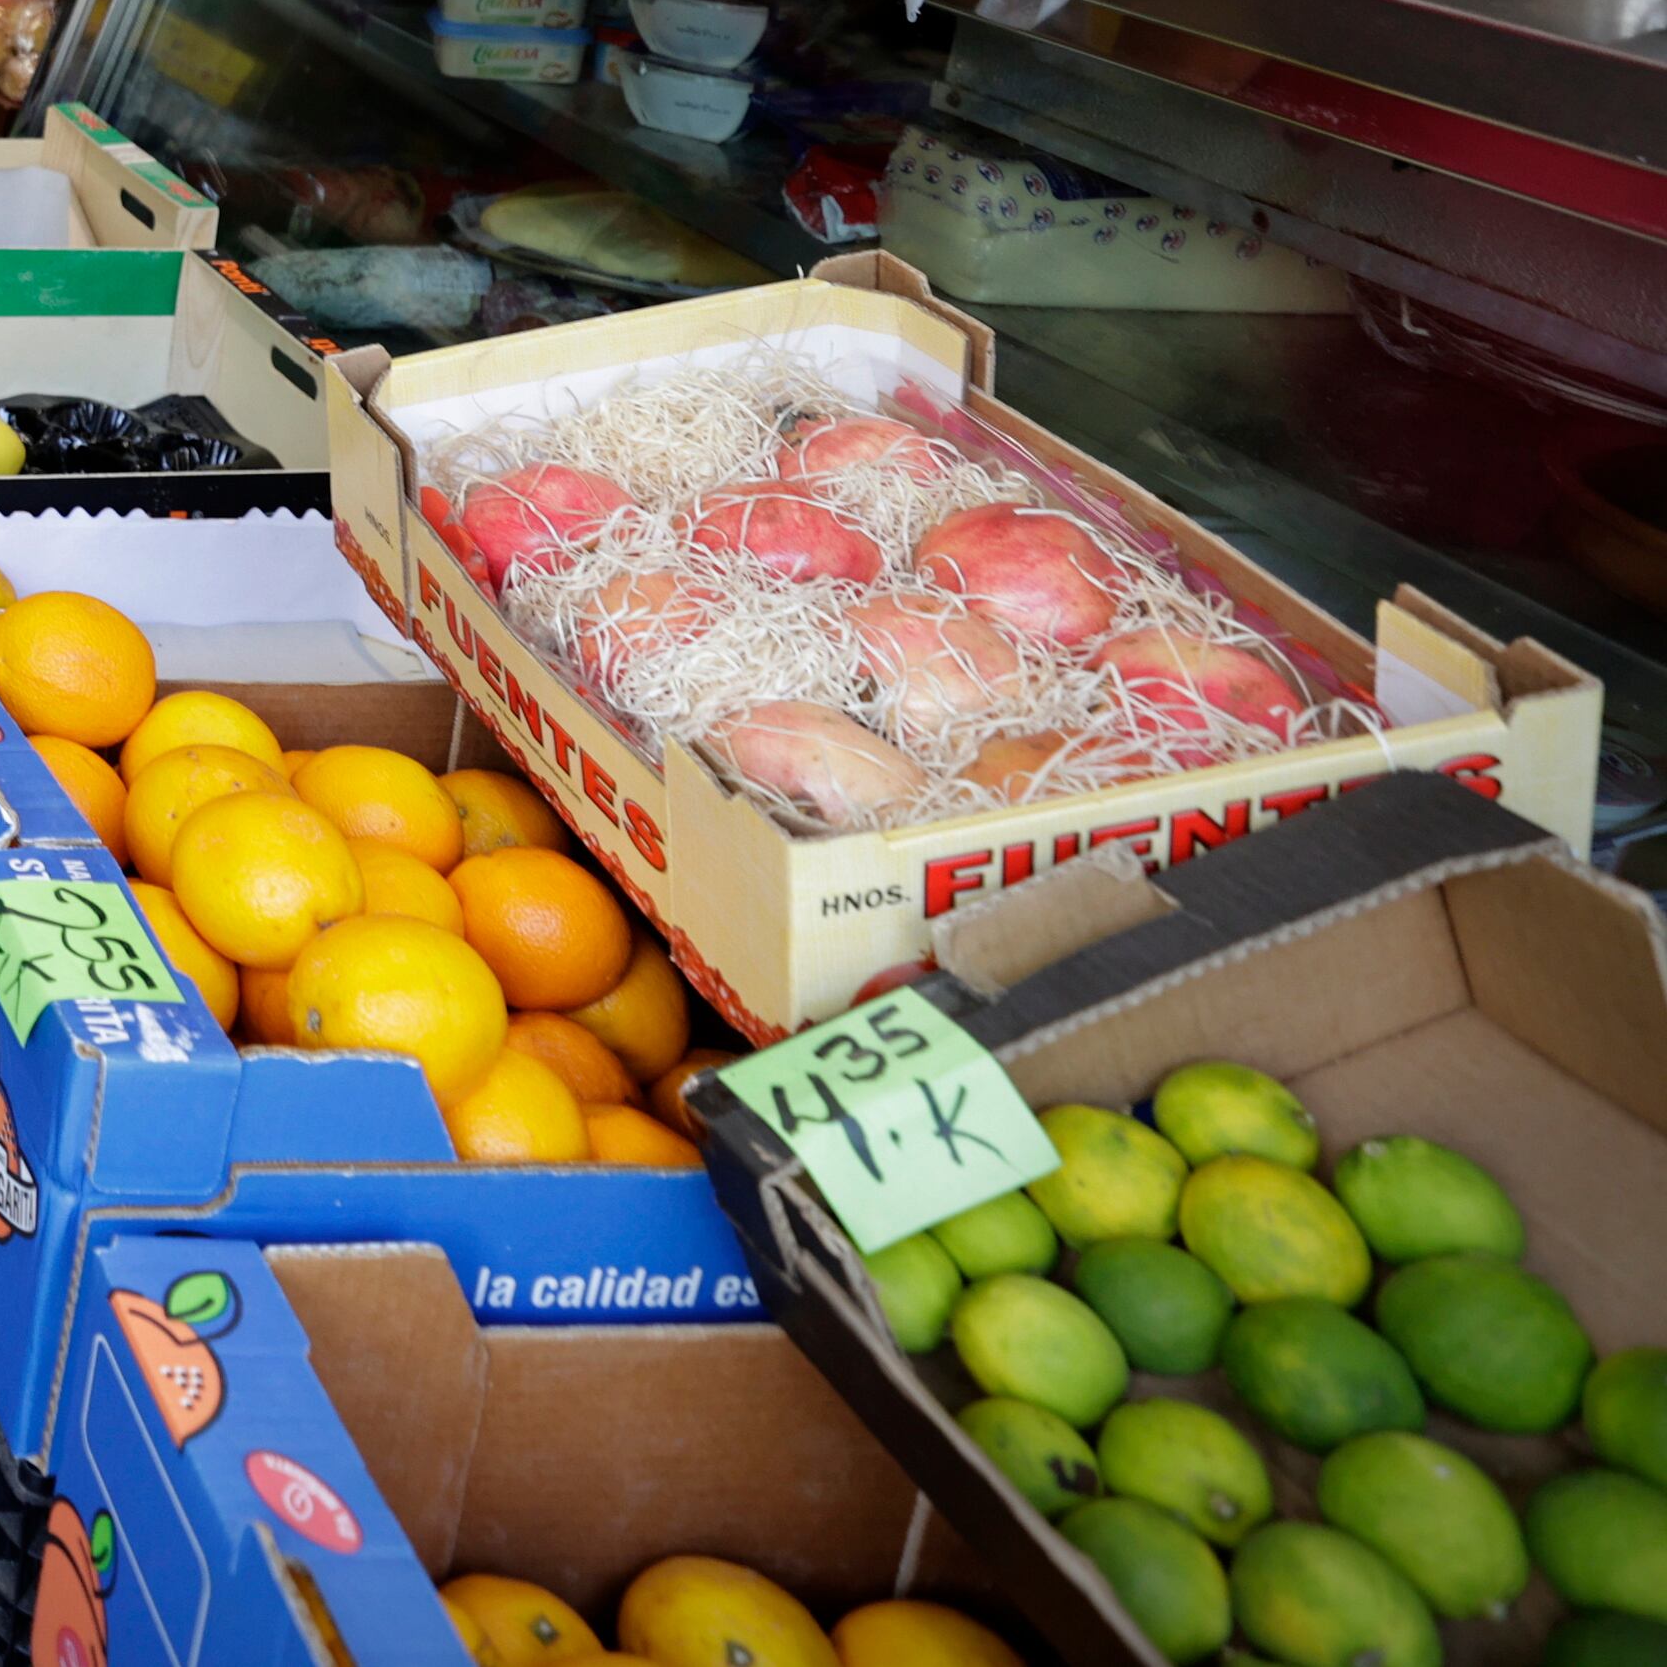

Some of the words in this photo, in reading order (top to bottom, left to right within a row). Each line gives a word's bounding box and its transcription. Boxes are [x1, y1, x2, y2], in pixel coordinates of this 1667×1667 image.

[416, 558, 668, 874] FUENTES
[821, 885, 913, 918] HNOS.
[473, 1266, 517, 1308] la
[529, 1266, 704, 1309] calidad
